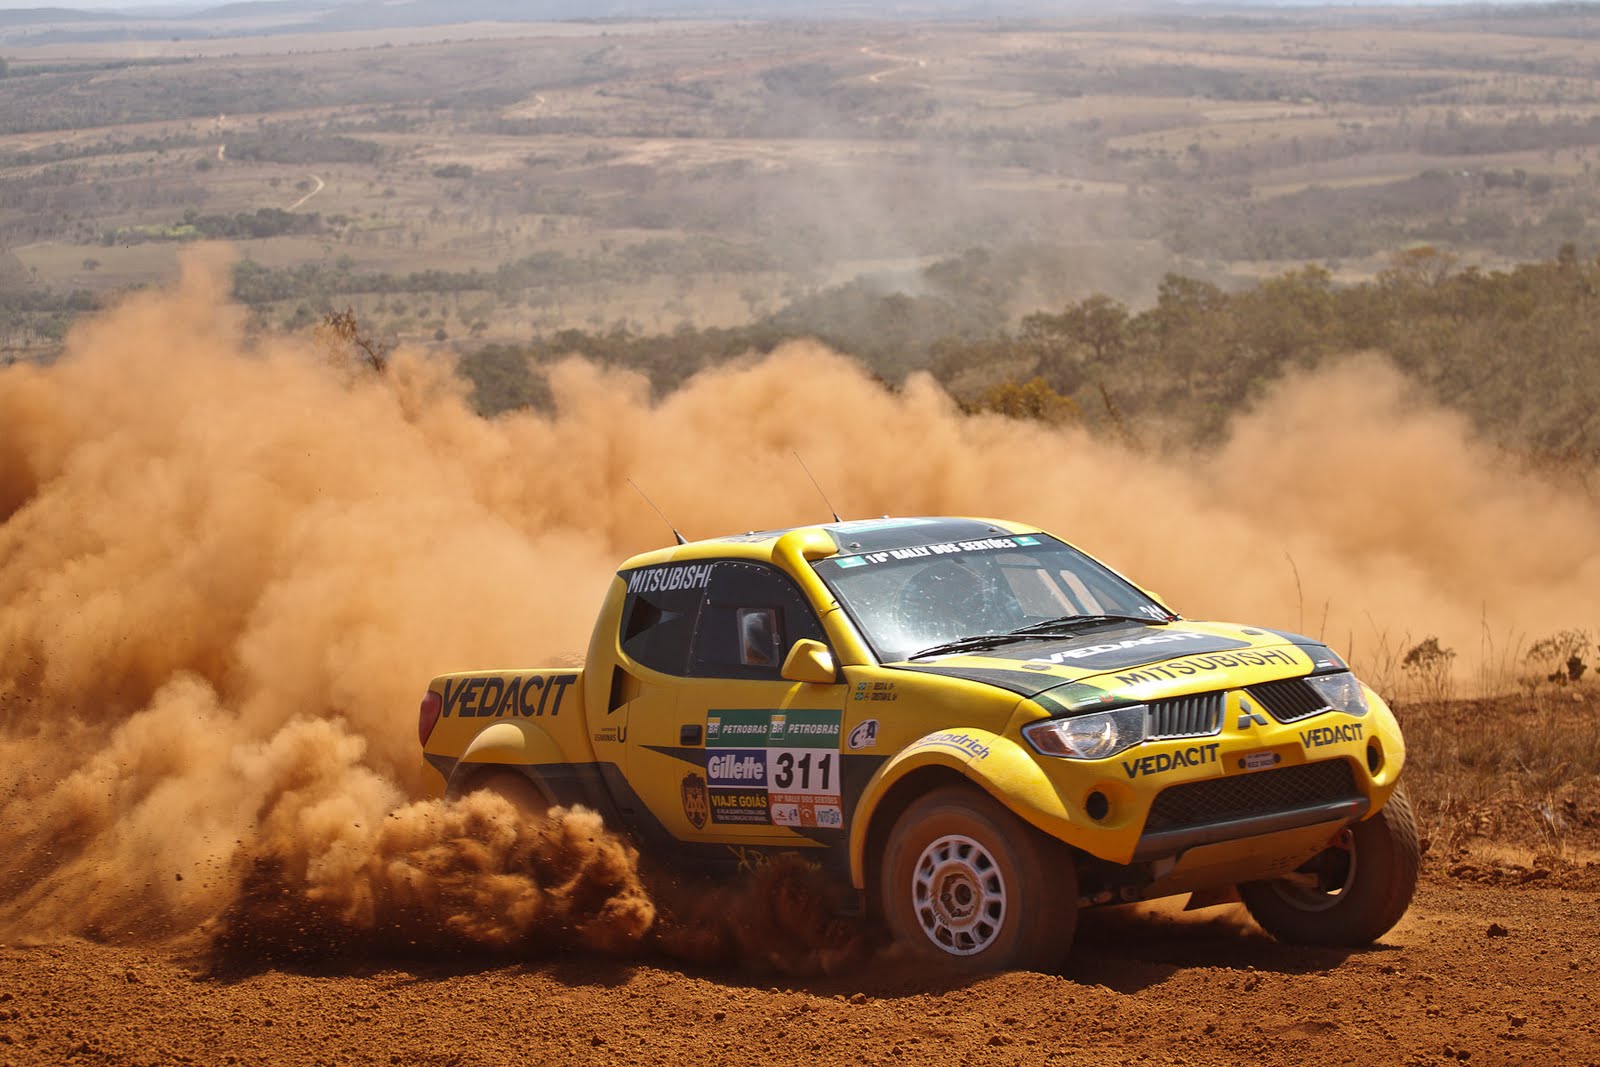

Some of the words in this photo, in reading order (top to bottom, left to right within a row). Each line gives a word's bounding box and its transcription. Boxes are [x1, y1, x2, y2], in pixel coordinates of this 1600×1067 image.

[890, 546, 931, 560] RALLY
[929, 543, 962, 555] DOS
[627, 564, 713, 593] MITSUBISHI
[1026, 631, 1205, 665] VEDACIT
[1115, 649, 1299, 687] MITSUBISHI
[442, 674, 578, 718] VEDACIT
[722, 724, 768, 734] PETROBRAS
[788, 724, 840, 735] PETROBRAS
[1299, 723, 1363, 749] VEDACIT
[708, 754, 765, 780] Gillette
[775, 752, 832, 790] 311
[1122, 743, 1221, 779] VEDACIT
[711, 796, 738, 808] VIAJE
[738, 793, 768, 809] GOIÁS
